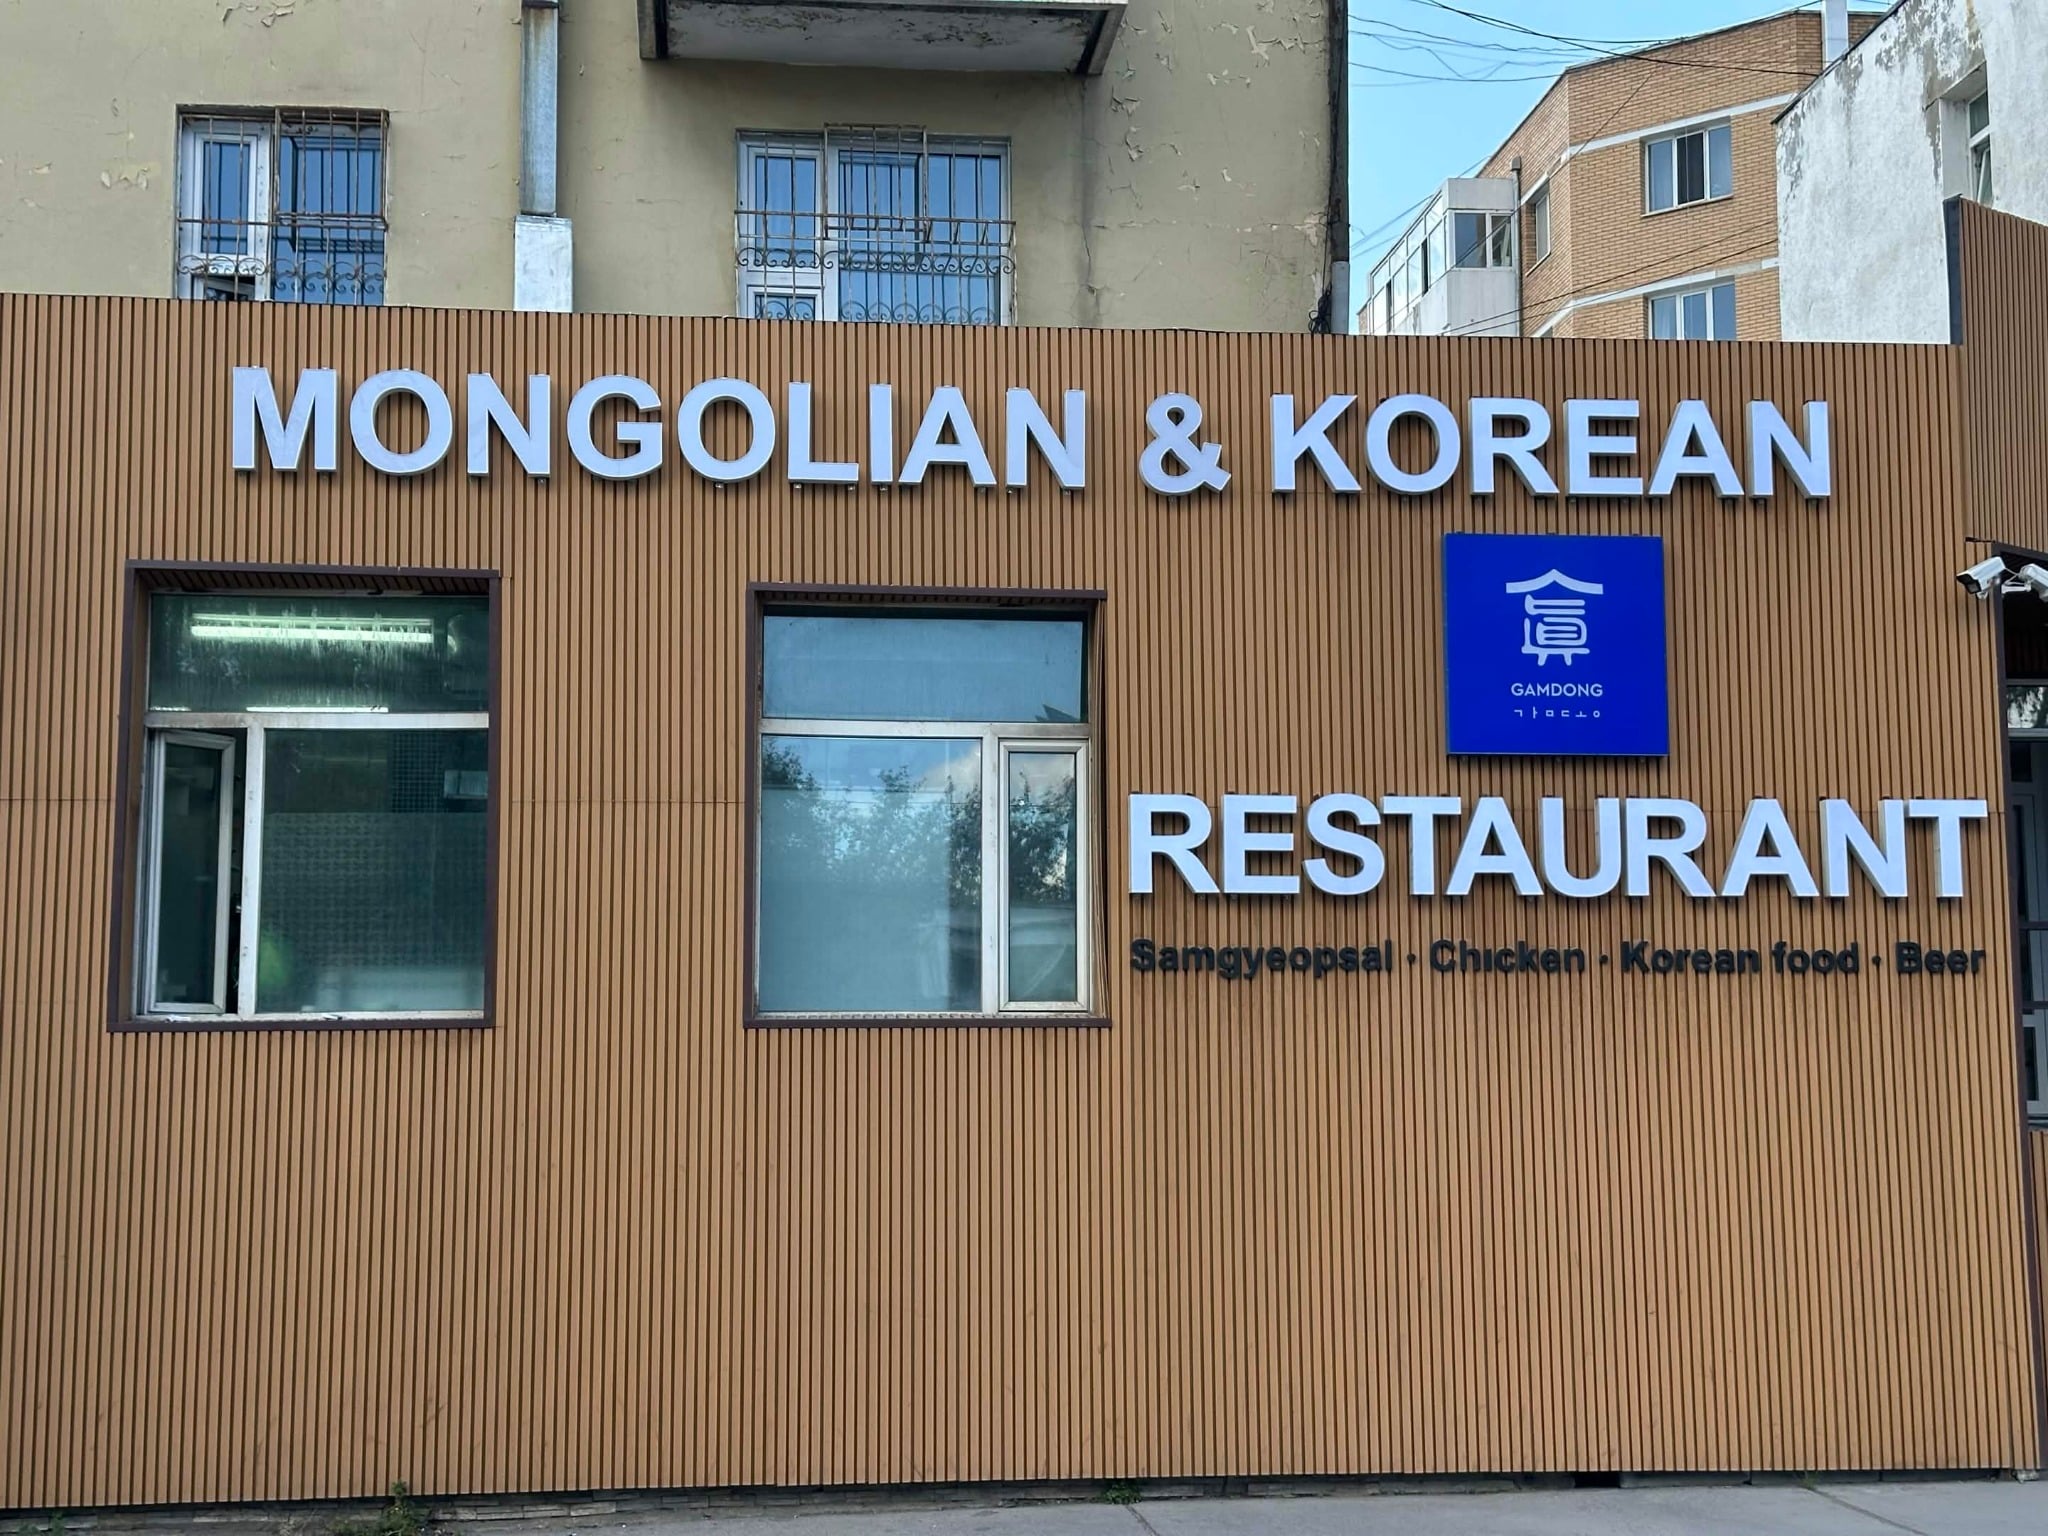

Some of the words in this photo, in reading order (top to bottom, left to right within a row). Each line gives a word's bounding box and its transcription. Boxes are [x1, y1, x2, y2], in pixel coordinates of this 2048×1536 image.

[230, 365, 1088, 491] MONGOLIAN
[1138, 392, 1233, 497] &
[1269, 393, 1832, 499] KOREAN
[1510, 682, 1604, 697] GAMDONG
[1127, 792, 1989, 901] RESTAURANT
[1130, 938, 1393, 980] Samgyeopsal
[1620, 940, 1760, 974] Korean
[1771, 941, 1859, 974] food
[1896, 941, 1986, 974] Beer
